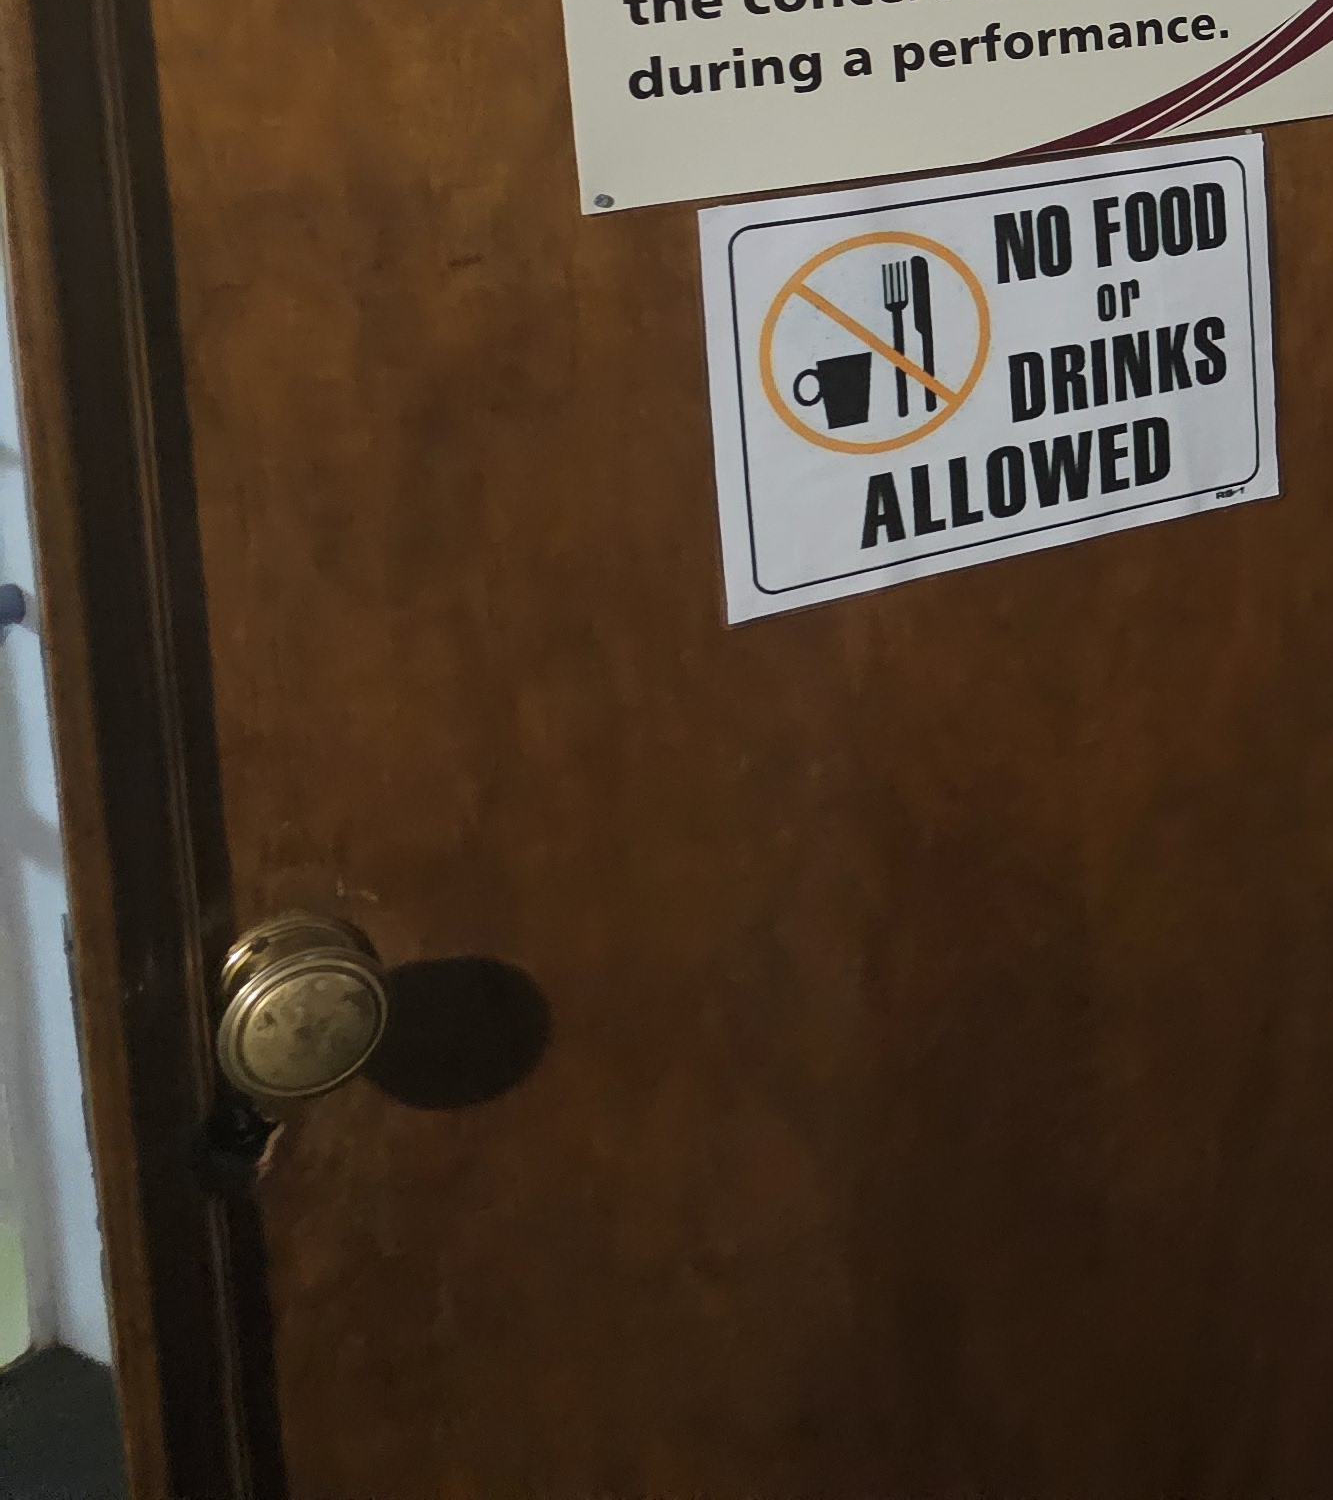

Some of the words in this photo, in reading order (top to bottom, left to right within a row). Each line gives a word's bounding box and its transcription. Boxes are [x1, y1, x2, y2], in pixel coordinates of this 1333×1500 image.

[628, 47, 822, 100] during
[843, 47, 873, 77] a
[892, 14, 1229, 83] performance.
[993, 204, 1073, 285] NO
[1092, 182, 1227, 269] FOOD
[1096, 278, 1140, 322] or
[1007, 316, 1227, 424] DRINKS
[860, 416, 1171, 550] ALLOWED
